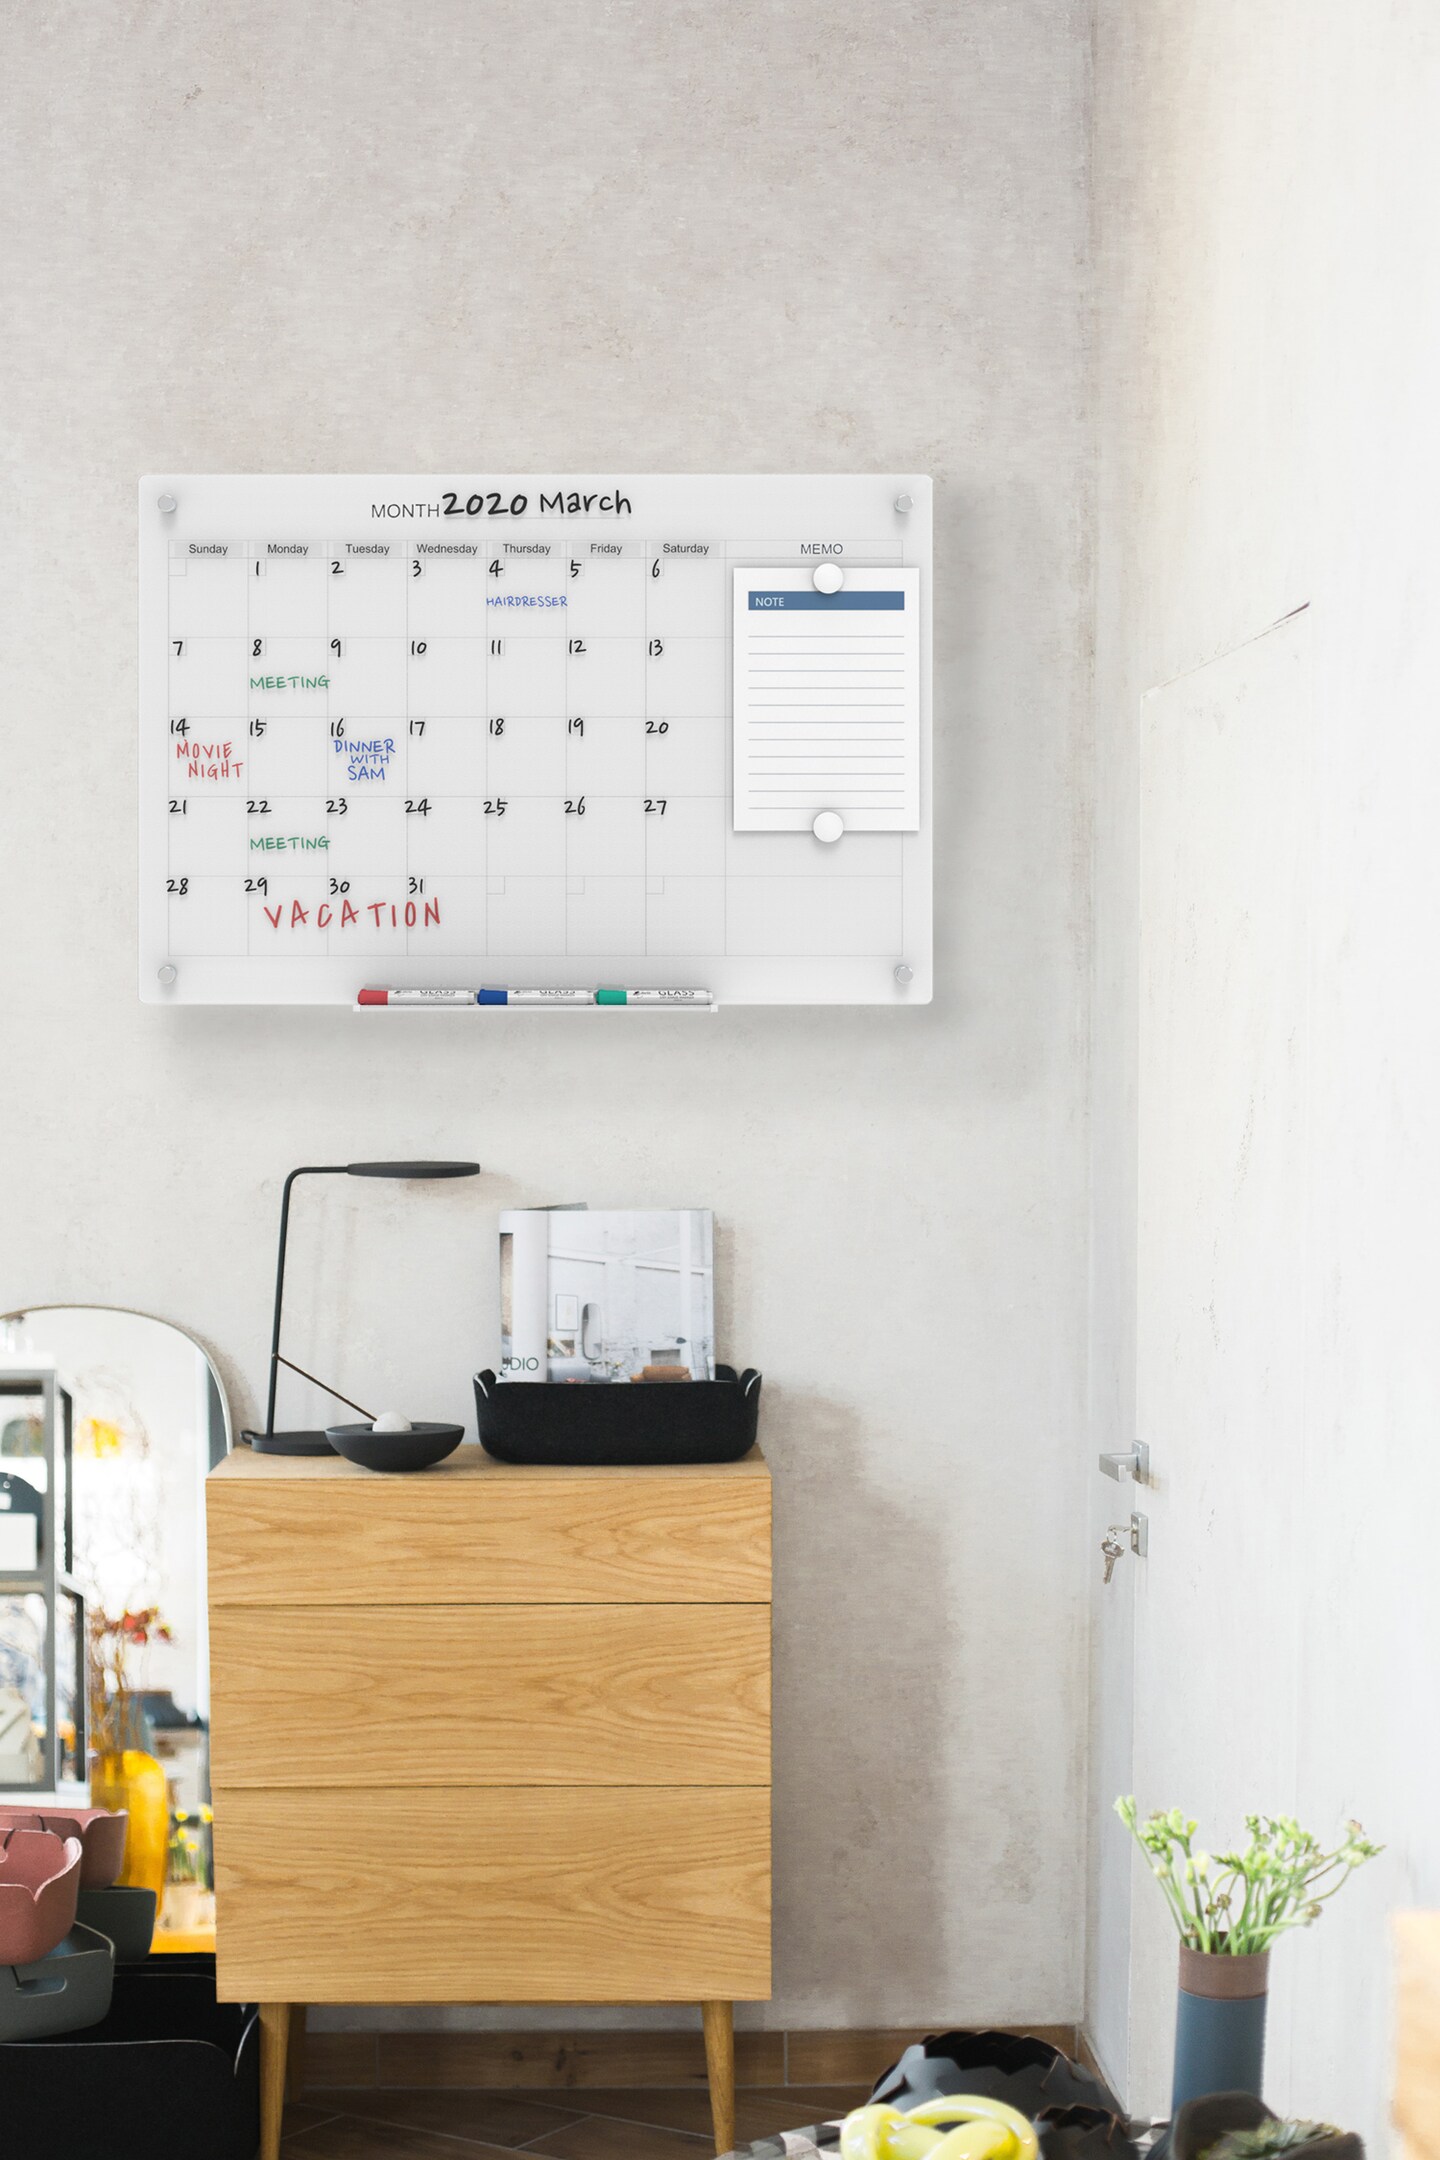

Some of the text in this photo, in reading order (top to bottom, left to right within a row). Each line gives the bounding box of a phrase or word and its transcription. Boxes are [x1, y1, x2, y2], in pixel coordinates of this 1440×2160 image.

[372, 504, 439, 518] MONTH
[442, 490, 631, 515] 2020 March
[189, 544, 228, 555] Sunday
[268, 544, 308, 555] Monday
[346, 544, 389, 555] Tuesday
[417, 544, 477, 555] Wednesday
[503, 544, 550, 555] Thursday
[591, 544, 622, 555] Friday
[663, 543, 709, 555] Saturday
[801, 544, 843, 554] MEMO
[255, 561, 260, 576] 1
[331, 561, 345, 575] 2
[412, 559, 422, 578] 3
[488, 559, 504, 578] 4
[570, 559, 582, 578] 5
[651, 558, 661, 578] 6
[487, 596, 567, 607] HAIRDRESSER
[755, 597, 785, 607] NOTE
[172, 640, 183, 657] 7
[252, 638, 263, 657] 8
[330, 638, 341, 658] 9
[411, 640, 427, 656] 10
[491, 639, 502, 655] 11
[568, 639, 587, 655] 12
[648, 639, 664, 657] 13
[251, 675, 330, 689] MEETING
[170, 717, 191, 737] 14
[249, 718, 267, 737] 15
[330, 717, 345, 738] 16
[409, 719, 426, 737] 17
[489, 717, 505, 736] 18
[568, 717, 584, 737] 19
[645, 720, 669, 735] 20
[177, 740, 231, 758] MOVIE
[334, 739, 396, 753] DINNER
[351, 754, 389, 764] WITH
[189, 760, 243, 780] NIGHT
[348, 765, 385, 780] SAM
[168, 799, 187, 815] 21
[246, 800, 272, 814] 22
[325, 797, 348, 816] 23
[404, 798, 432, 817] 24
[483, 797, 509, 817] 25
[563, 796, 586, 816] 26
[643, 799, 667, 816] 27
[251, 836, 330, 850] MEETING
[166, 877, 189, 896] 28
[244, 877, 268, 897] 29
[329, 877, 351, 896] 30
[408, 876, 424, 895] 31
[264, 897, 441, 928] VACATION
